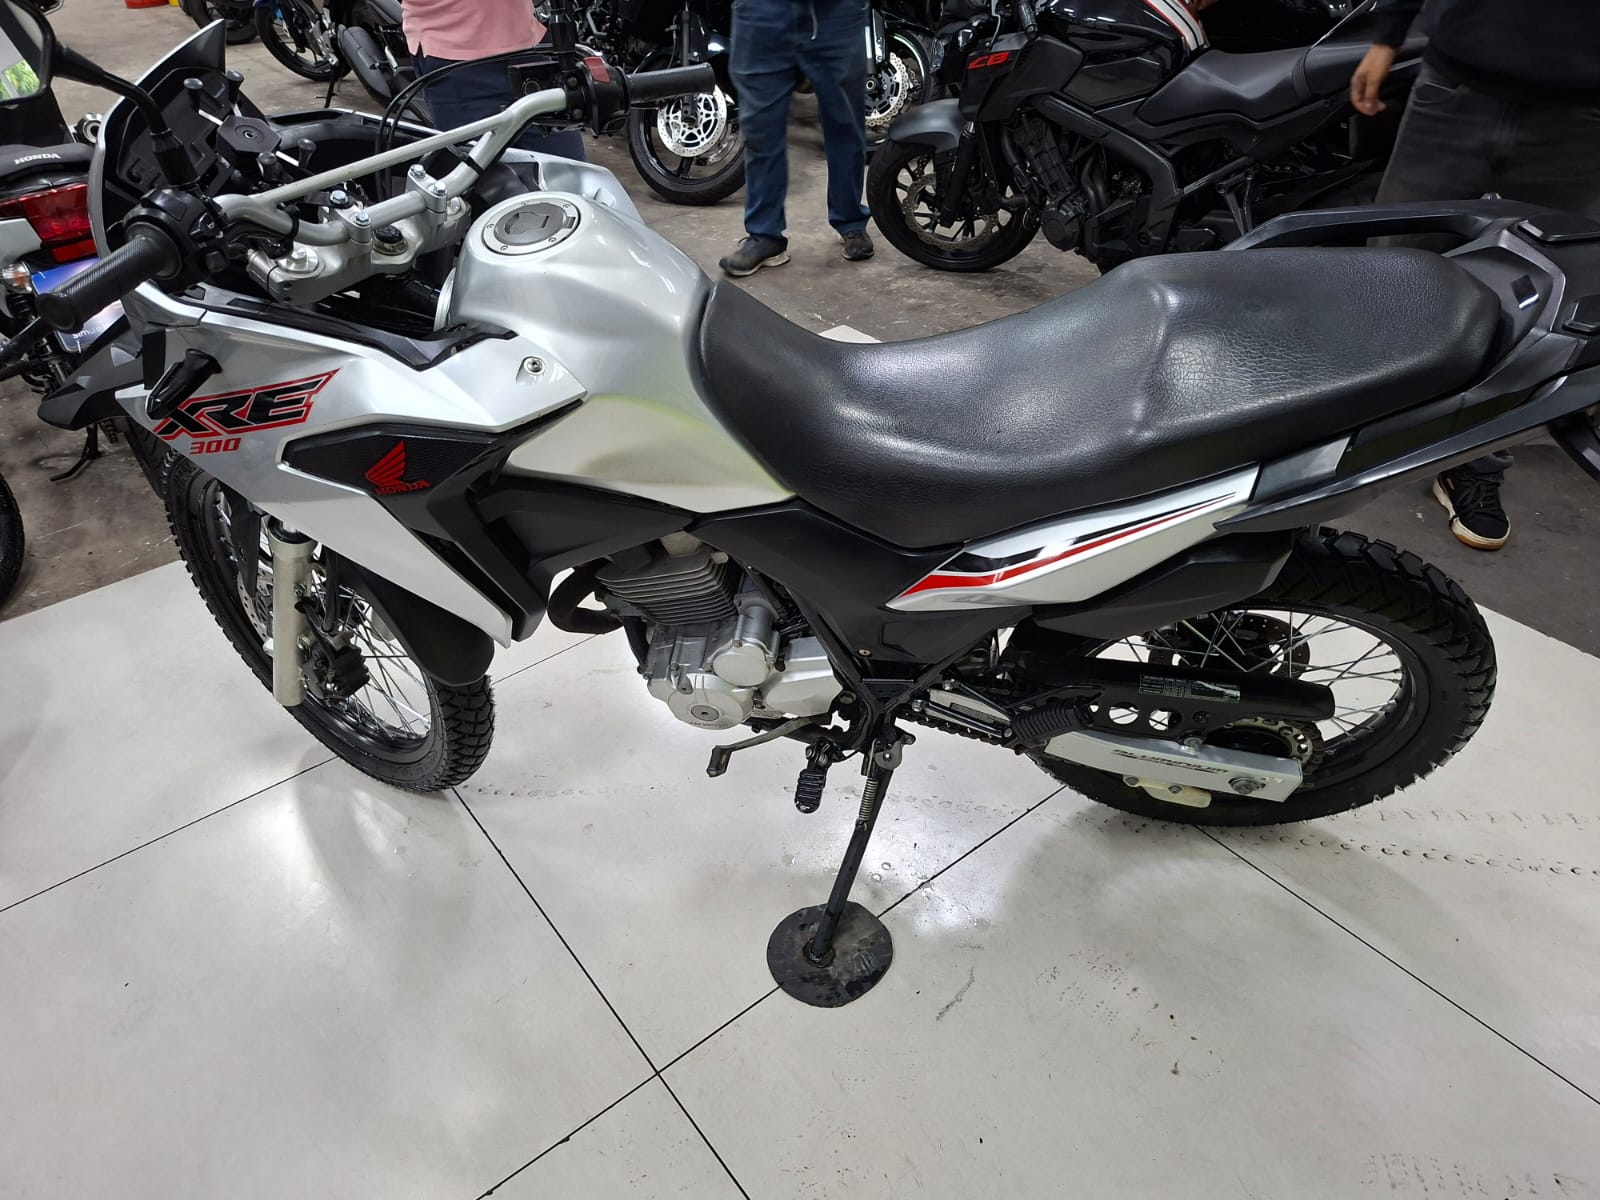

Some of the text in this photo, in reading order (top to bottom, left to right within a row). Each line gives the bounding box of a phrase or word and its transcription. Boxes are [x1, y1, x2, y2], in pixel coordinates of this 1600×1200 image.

[967, 51, 1010, 69] CB
[14, 153, 62, 165] HONDA
[153, 369, 340, 440] XRE
[189, 437, 242, 455] 300
[374, 479, 431, 496] HONDA
